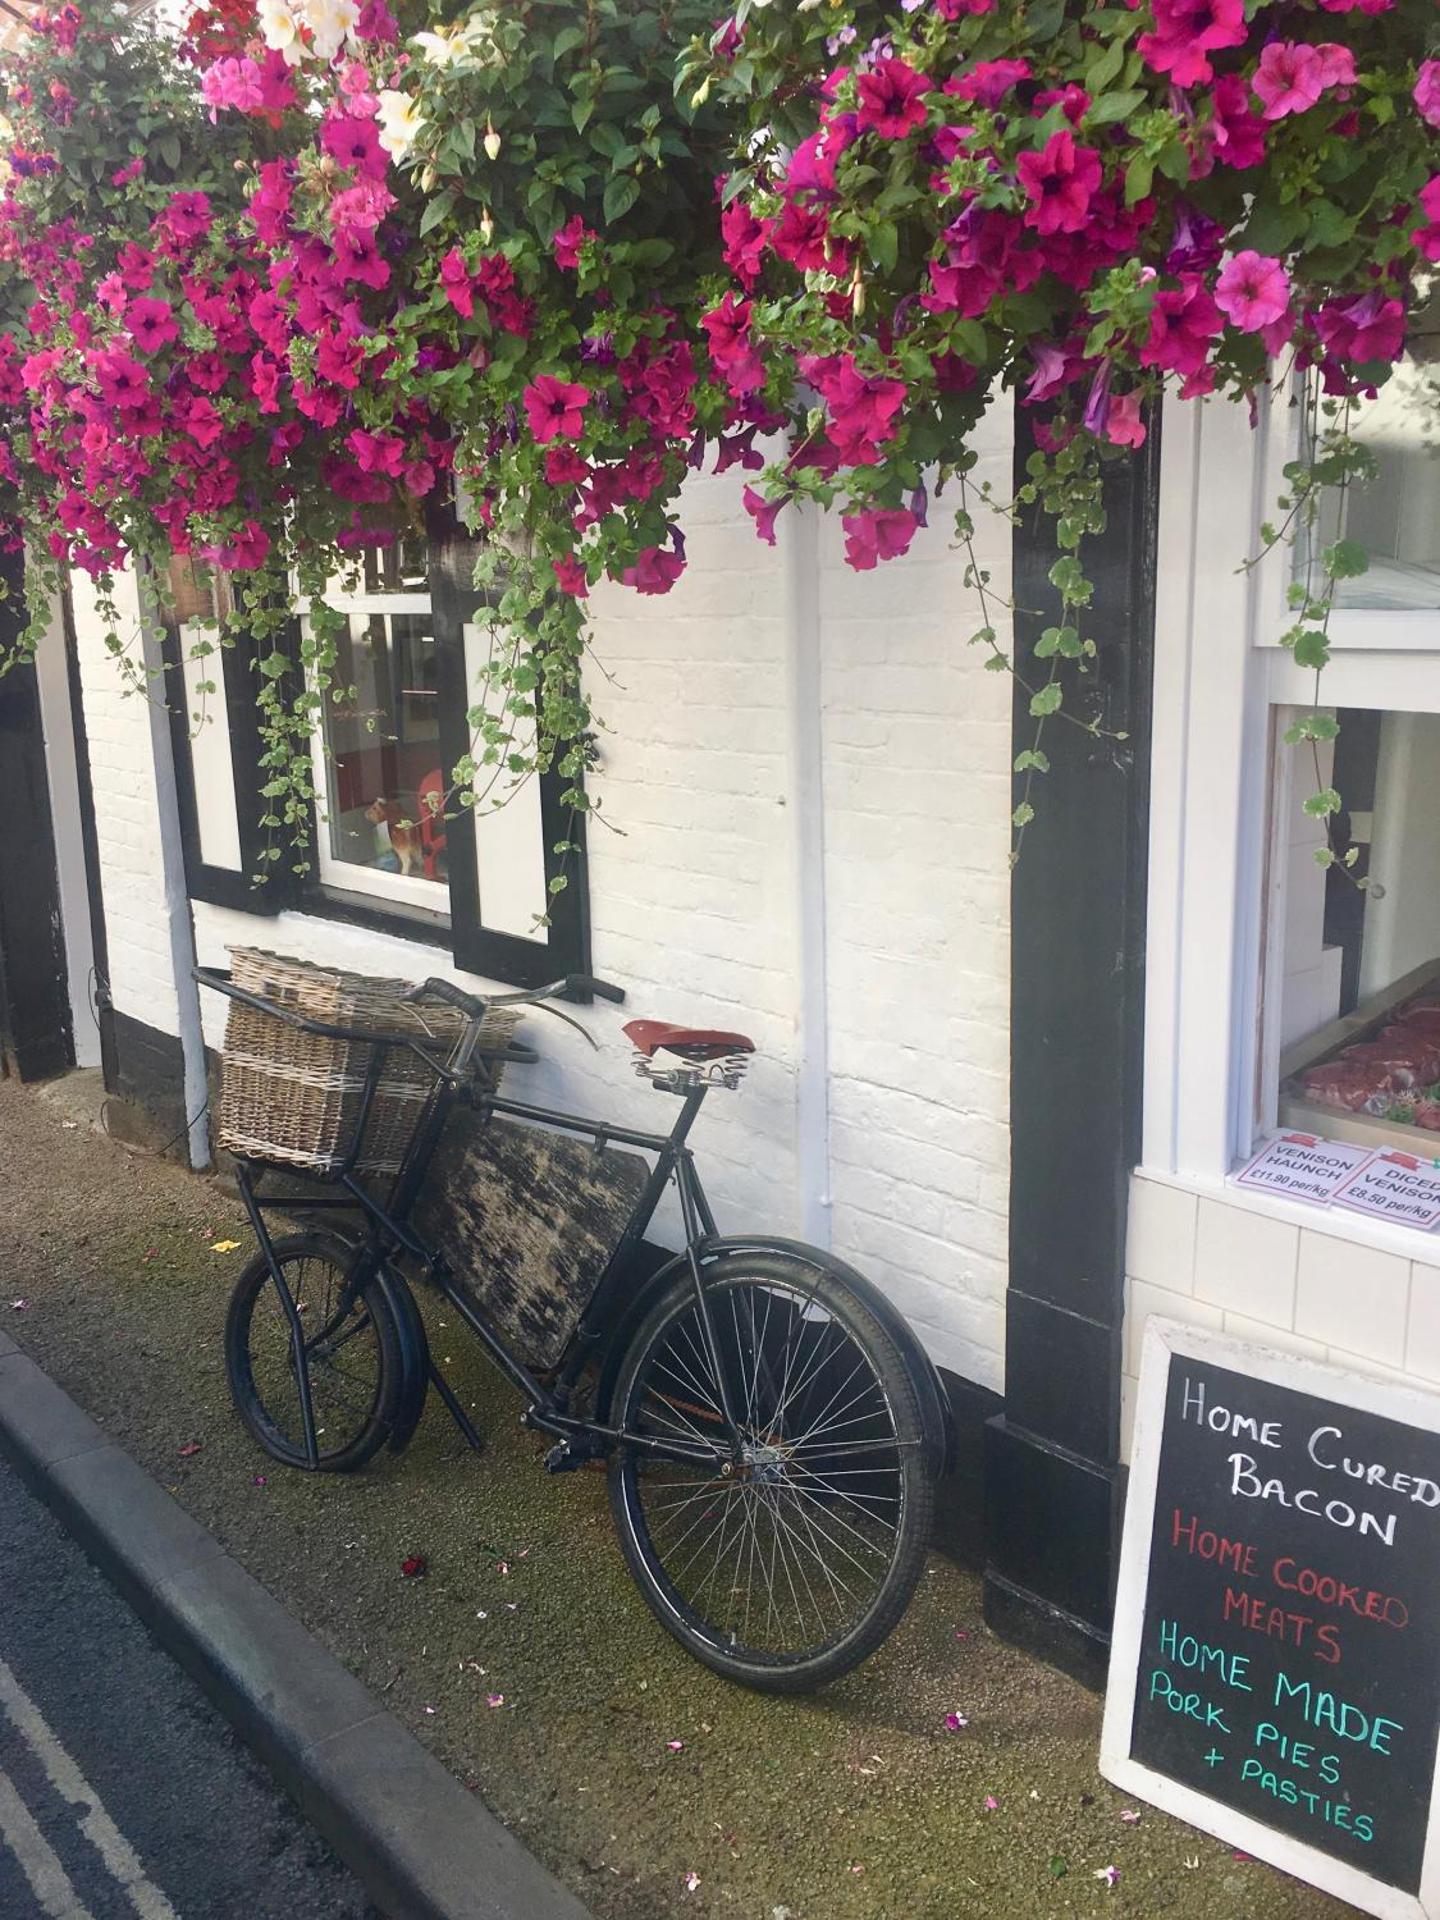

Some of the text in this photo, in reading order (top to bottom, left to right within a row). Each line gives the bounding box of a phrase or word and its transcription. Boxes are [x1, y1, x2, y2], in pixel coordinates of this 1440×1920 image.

[1250, 1169, 1330, 1198] £11.90 per/kg
[1266, 1156, 1342, 1180] HAUNCH
[1276, 1146, 1354, 1171] VENISON
[1347, 1187, 1432, 1219] £8.50 per/kg
[1182, 1377, 1283, 1448] HOME
[1227, 1453, 1397, 1546] BACON
[1172, 1508, 1409, 1628] HOME COOKED
[1223, 1587, 1341, 1664] MEATS
[1160, 1618, 1404, 1756] HOME MADE
[1150, 1671, 1341, 1784] PORK PIES
[1241, 1759, 1374, 1842] PASTIES
